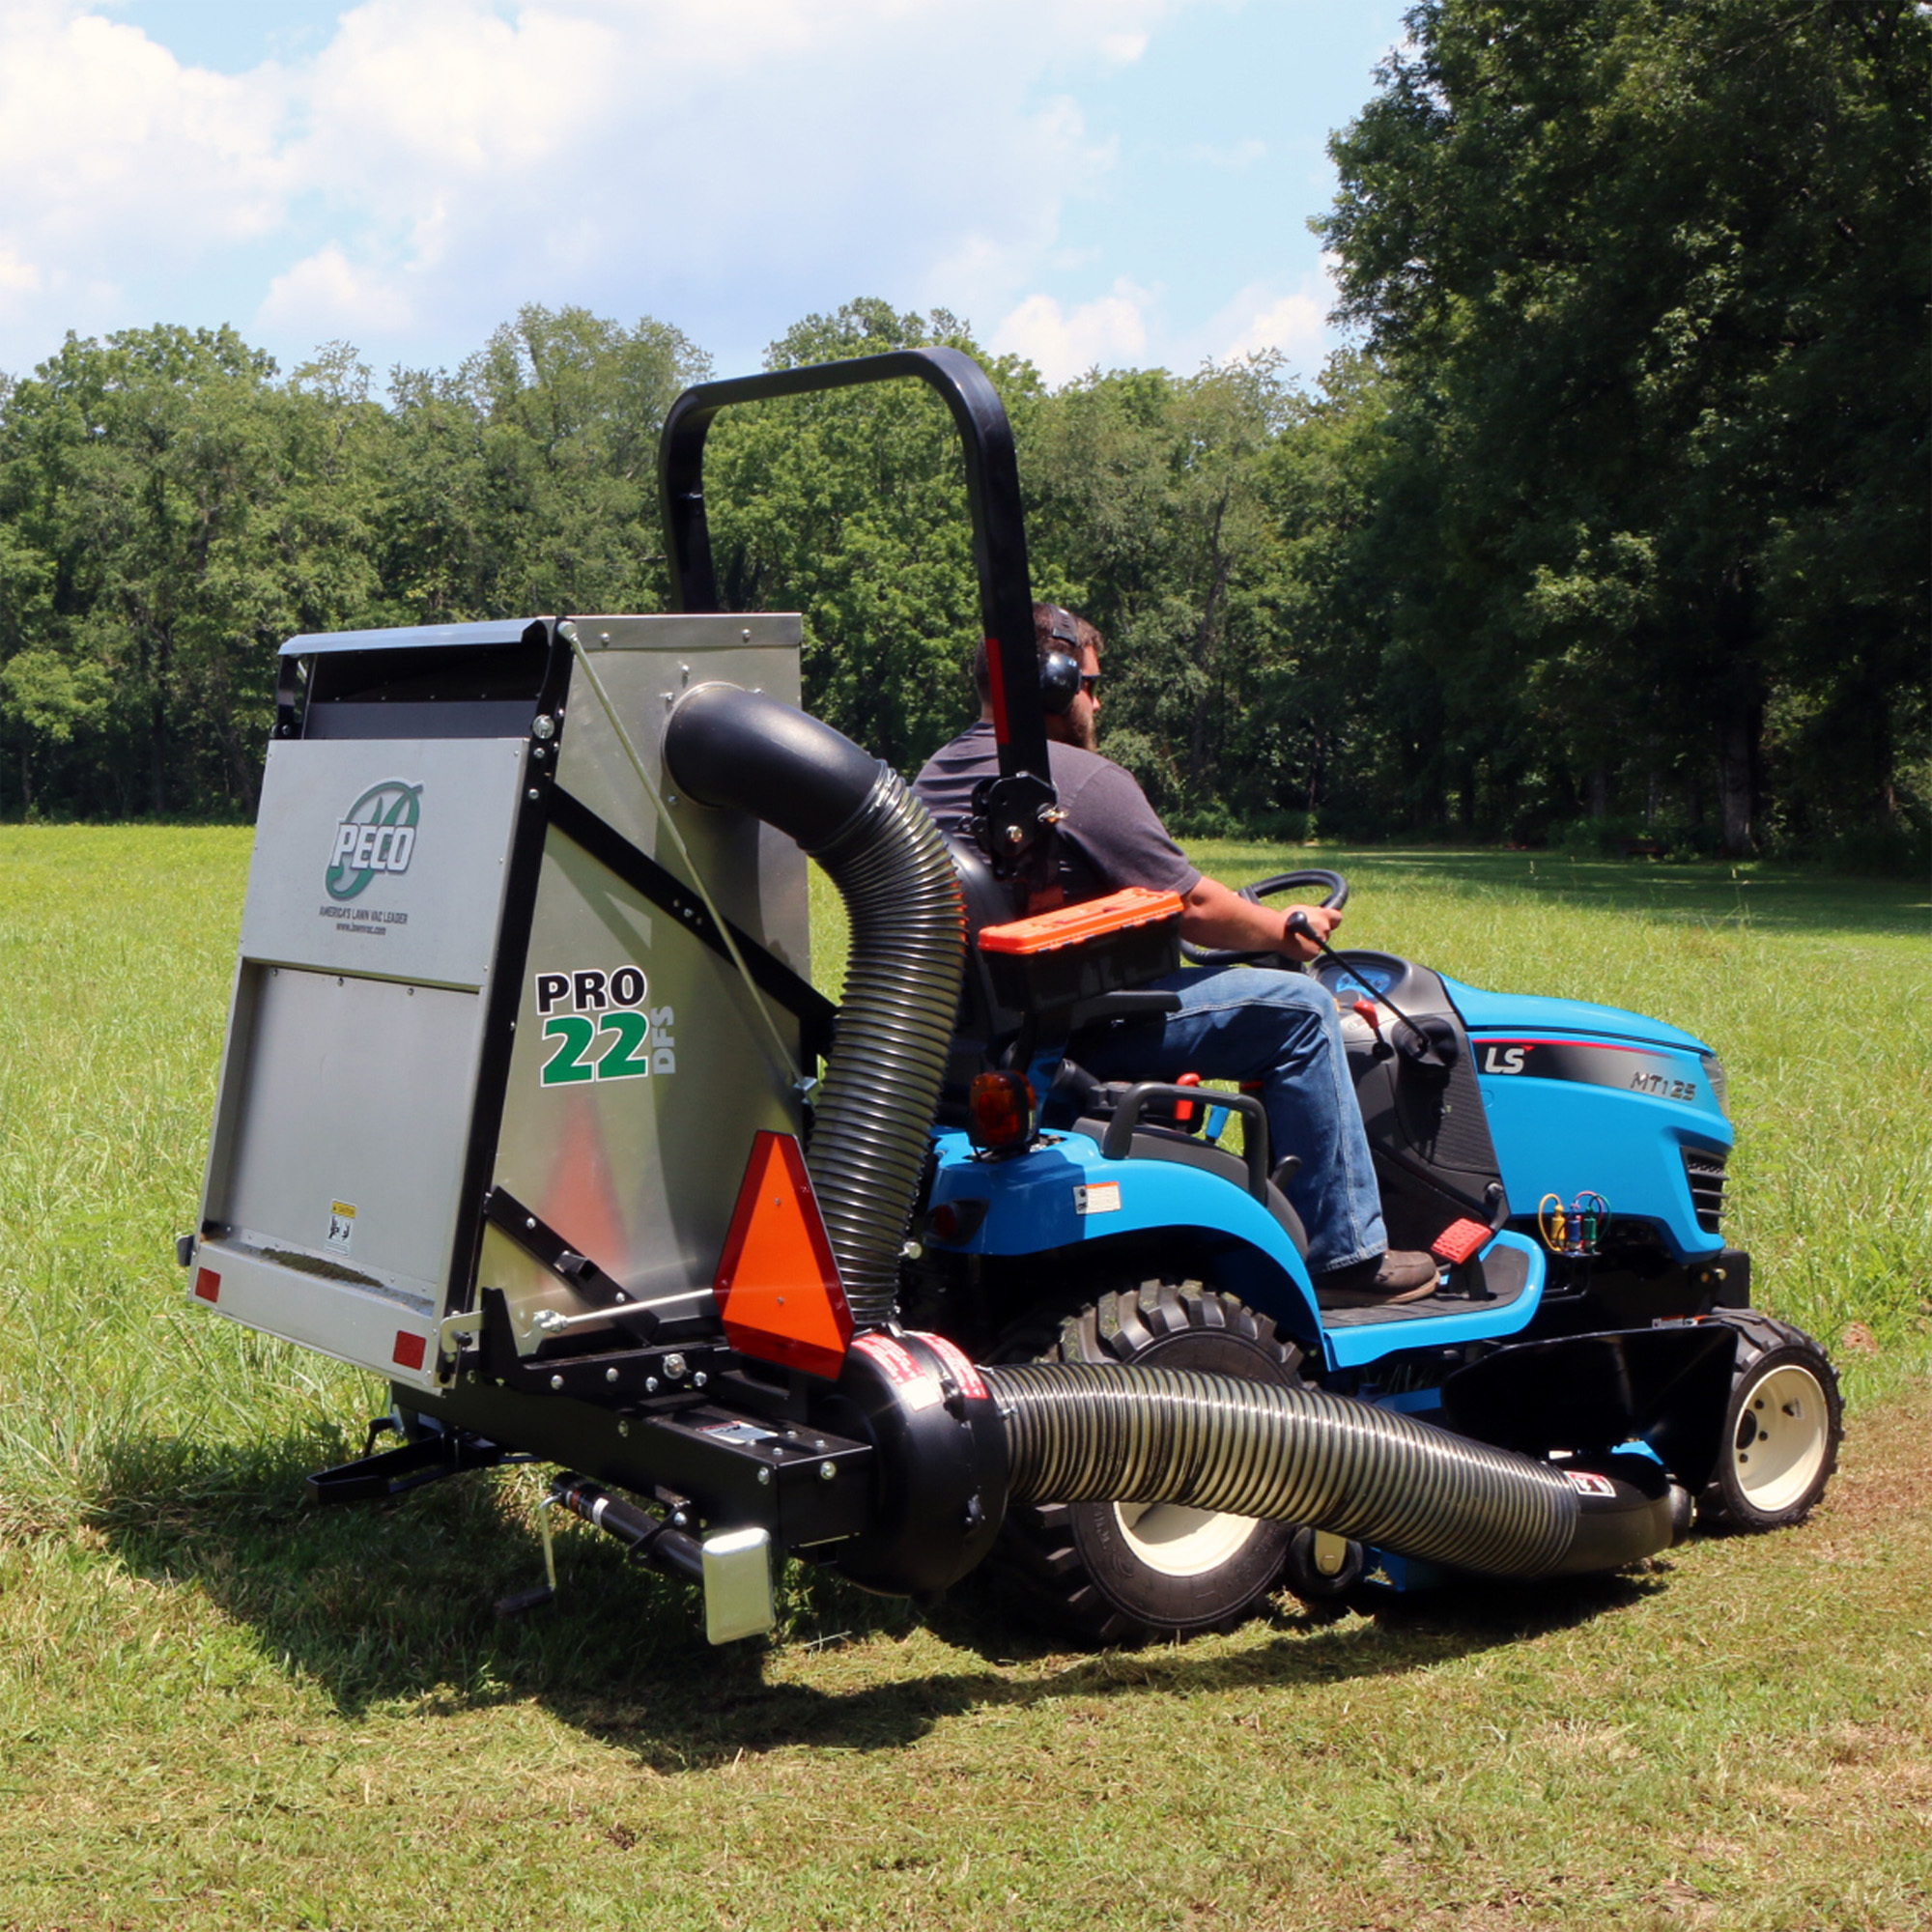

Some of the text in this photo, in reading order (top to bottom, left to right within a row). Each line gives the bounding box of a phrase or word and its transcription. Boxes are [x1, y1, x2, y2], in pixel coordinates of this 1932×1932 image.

[330, 822, 416, 873] PECO
[320, 906, 409, 924] AMERICA'S LAWN VAC LEADER
[535, 965, 647, 1015] PRO
[540, 1009, 649, 1088] 22
[651, 1006, 675, 1074] DFS
[1485, 1047, 1525, 1074] LS
[1630, 1071, 1696, 1101] MT125
